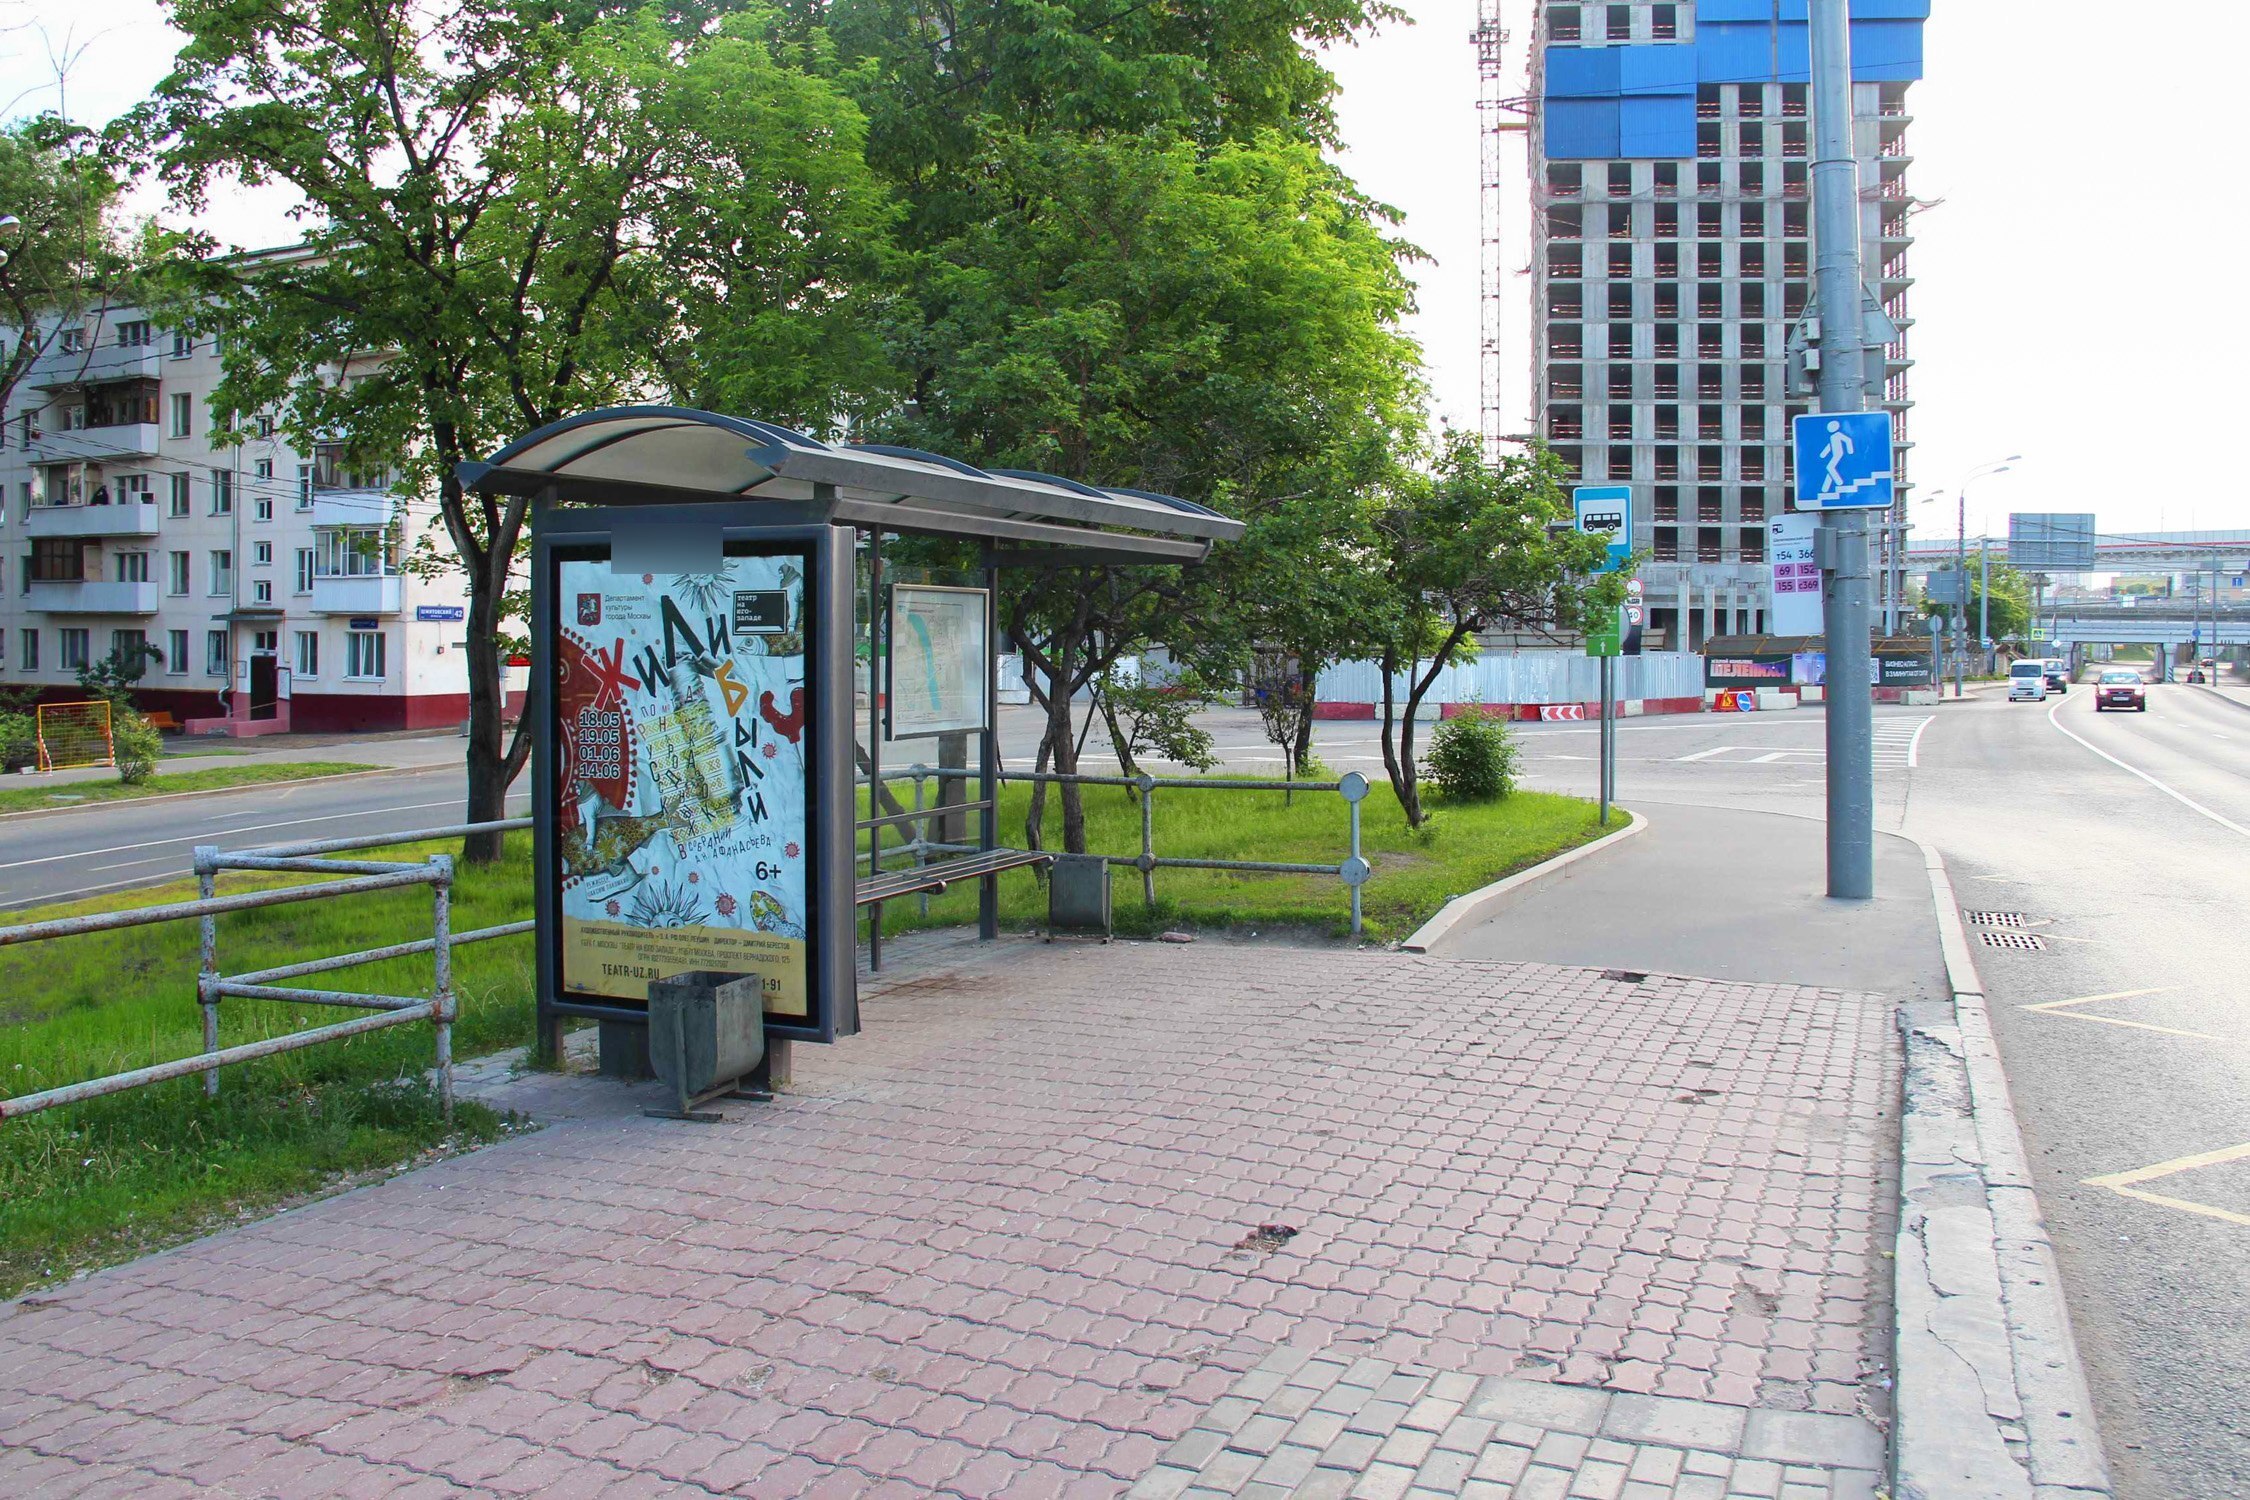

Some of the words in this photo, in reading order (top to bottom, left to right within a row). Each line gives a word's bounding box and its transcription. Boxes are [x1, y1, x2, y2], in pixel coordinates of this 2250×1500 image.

[1776, 550, 1792, 560] т54
[1779, 566, 1791, 575] 69
[1800, 565, 1815, 574] 152
[1778, 581, 1793, 591] 155
[605, 594, 645, 602] Департамент
[454, 610, 463, 618] 42
[580, 712, 620, 727] 18.05
[580, 729, 620, 744] 19.05
[580, 746, 620, 761] 01.06
[580, 763, 620, 778] 14.06
[712, 834, 771, 859] АФАНАСЬЕВА
[755, 861, 782, 880] 6+
[601, 963, 660, 980] TEATR-UZ.RU
